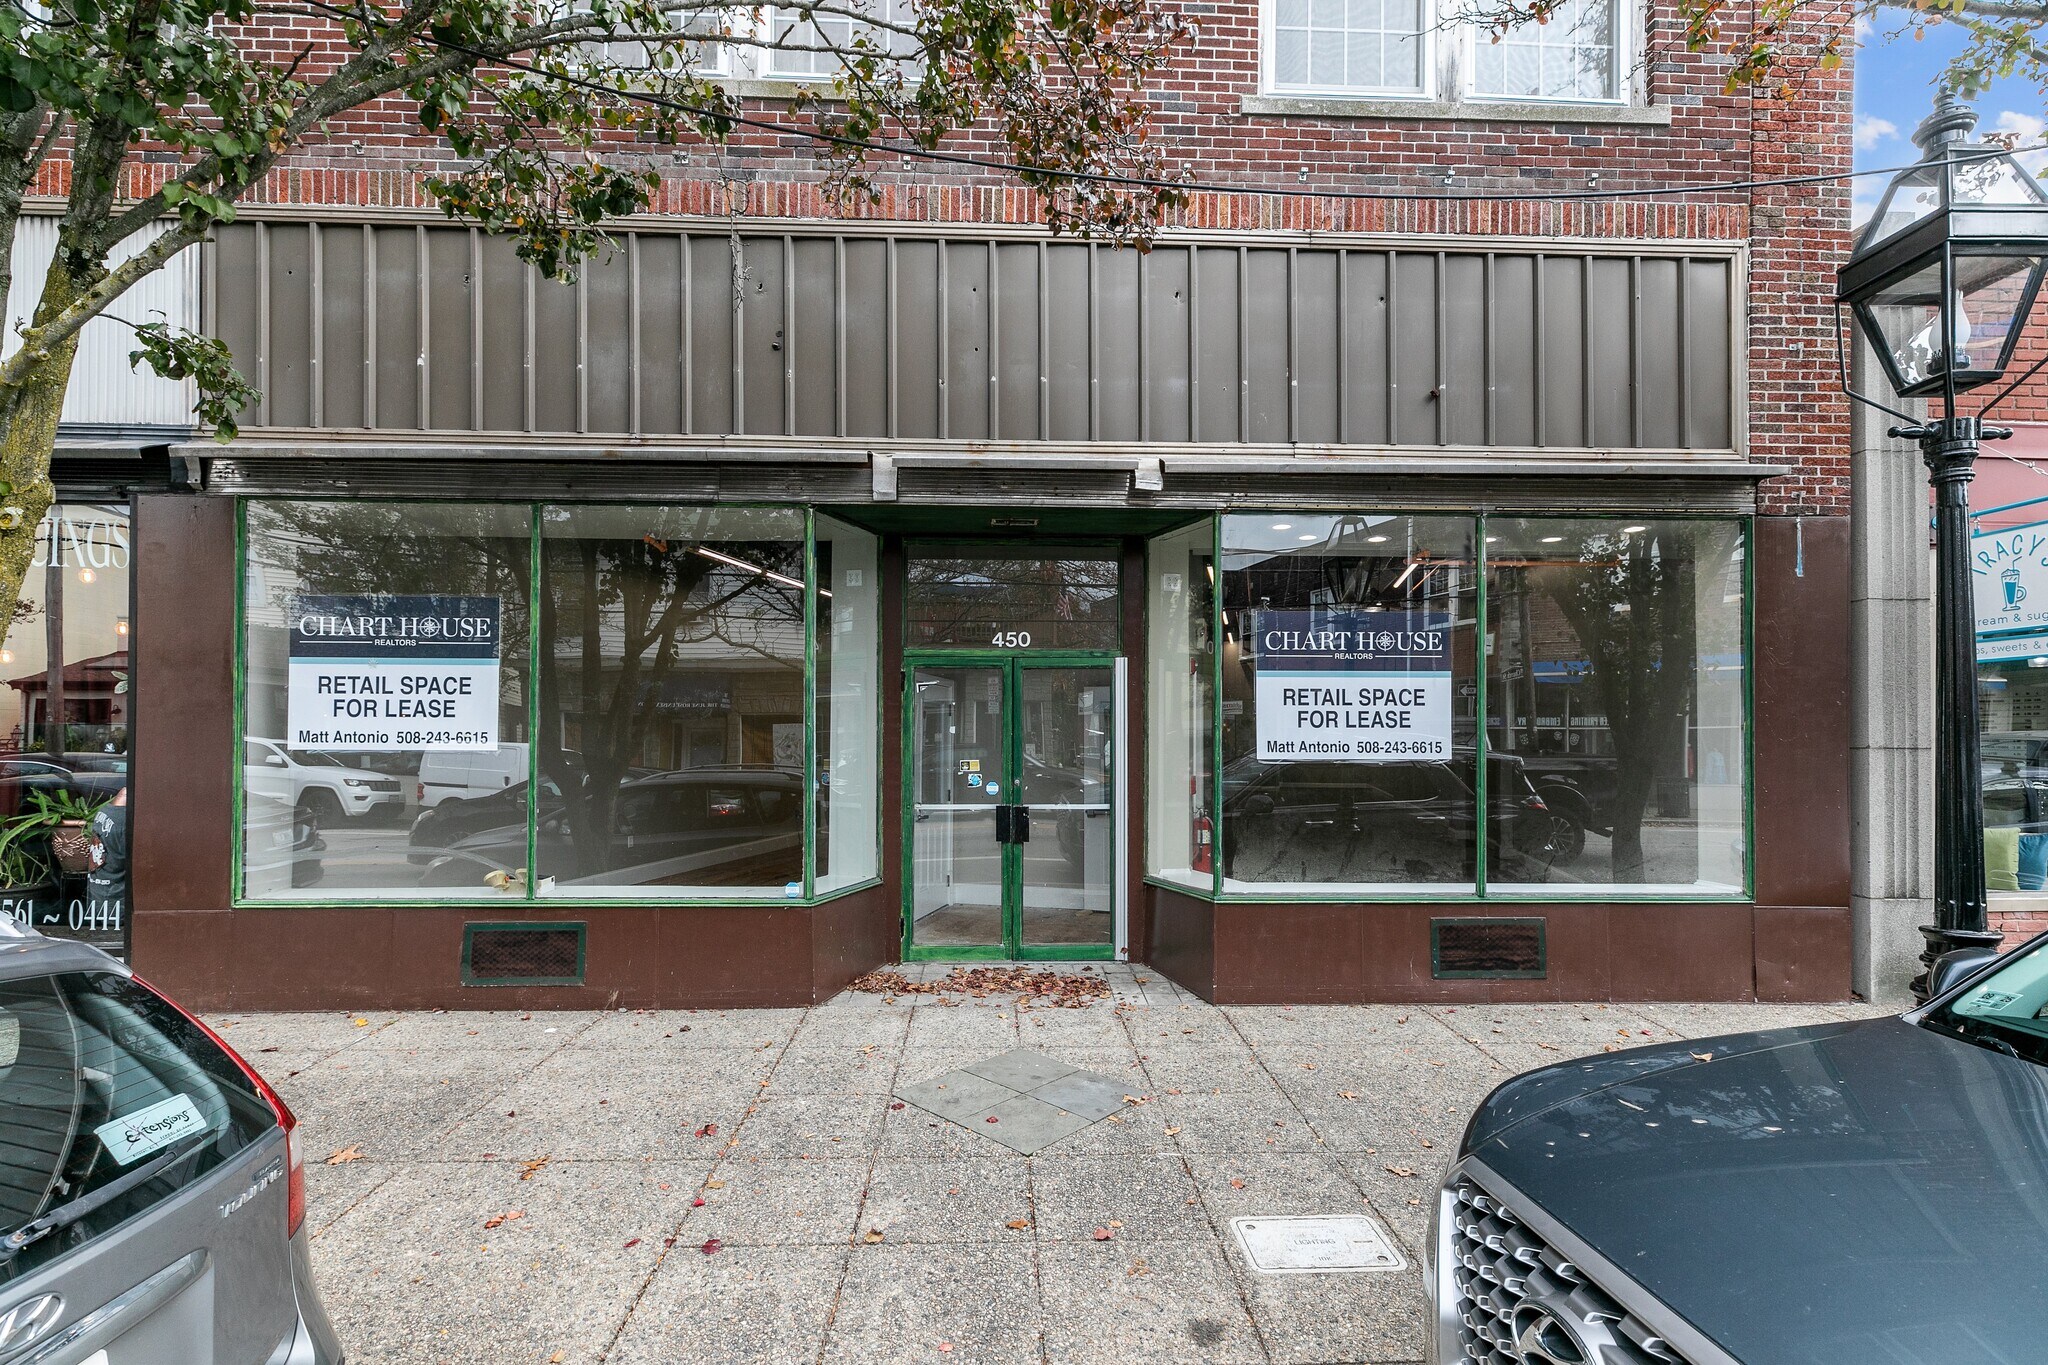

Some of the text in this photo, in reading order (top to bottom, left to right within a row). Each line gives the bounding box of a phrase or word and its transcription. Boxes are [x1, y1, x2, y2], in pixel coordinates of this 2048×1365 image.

[299, 615, 491, 638] CHART HOUSE
[1977, 615, 2008, 627] ream
[2013, 613, 2022, 623] &
[374, 639, 417, 647] REALTORS
[991, 631, 1031, 648] 450
[1265, 630, 1443, 652] CHART HOUSE
[1991, 642, 2028, 654] sweets
[1334, 652, 1374, 660] REALTORS
[318, 675, 472, 695] RETAIL SPACE
[1283, 688, 1426, 707] RETAIL SPACE
[333, 699, 456, 718] FOR LEASE
[1297, 710, 1411, 729] FOR LEASE
[299, 730, 488, 744] Matt Antonio 508-243-6615
[1267, 740, 1442, 754] Matt Antonio 508-243-6615
[68, 899, 121, 931] 0444
